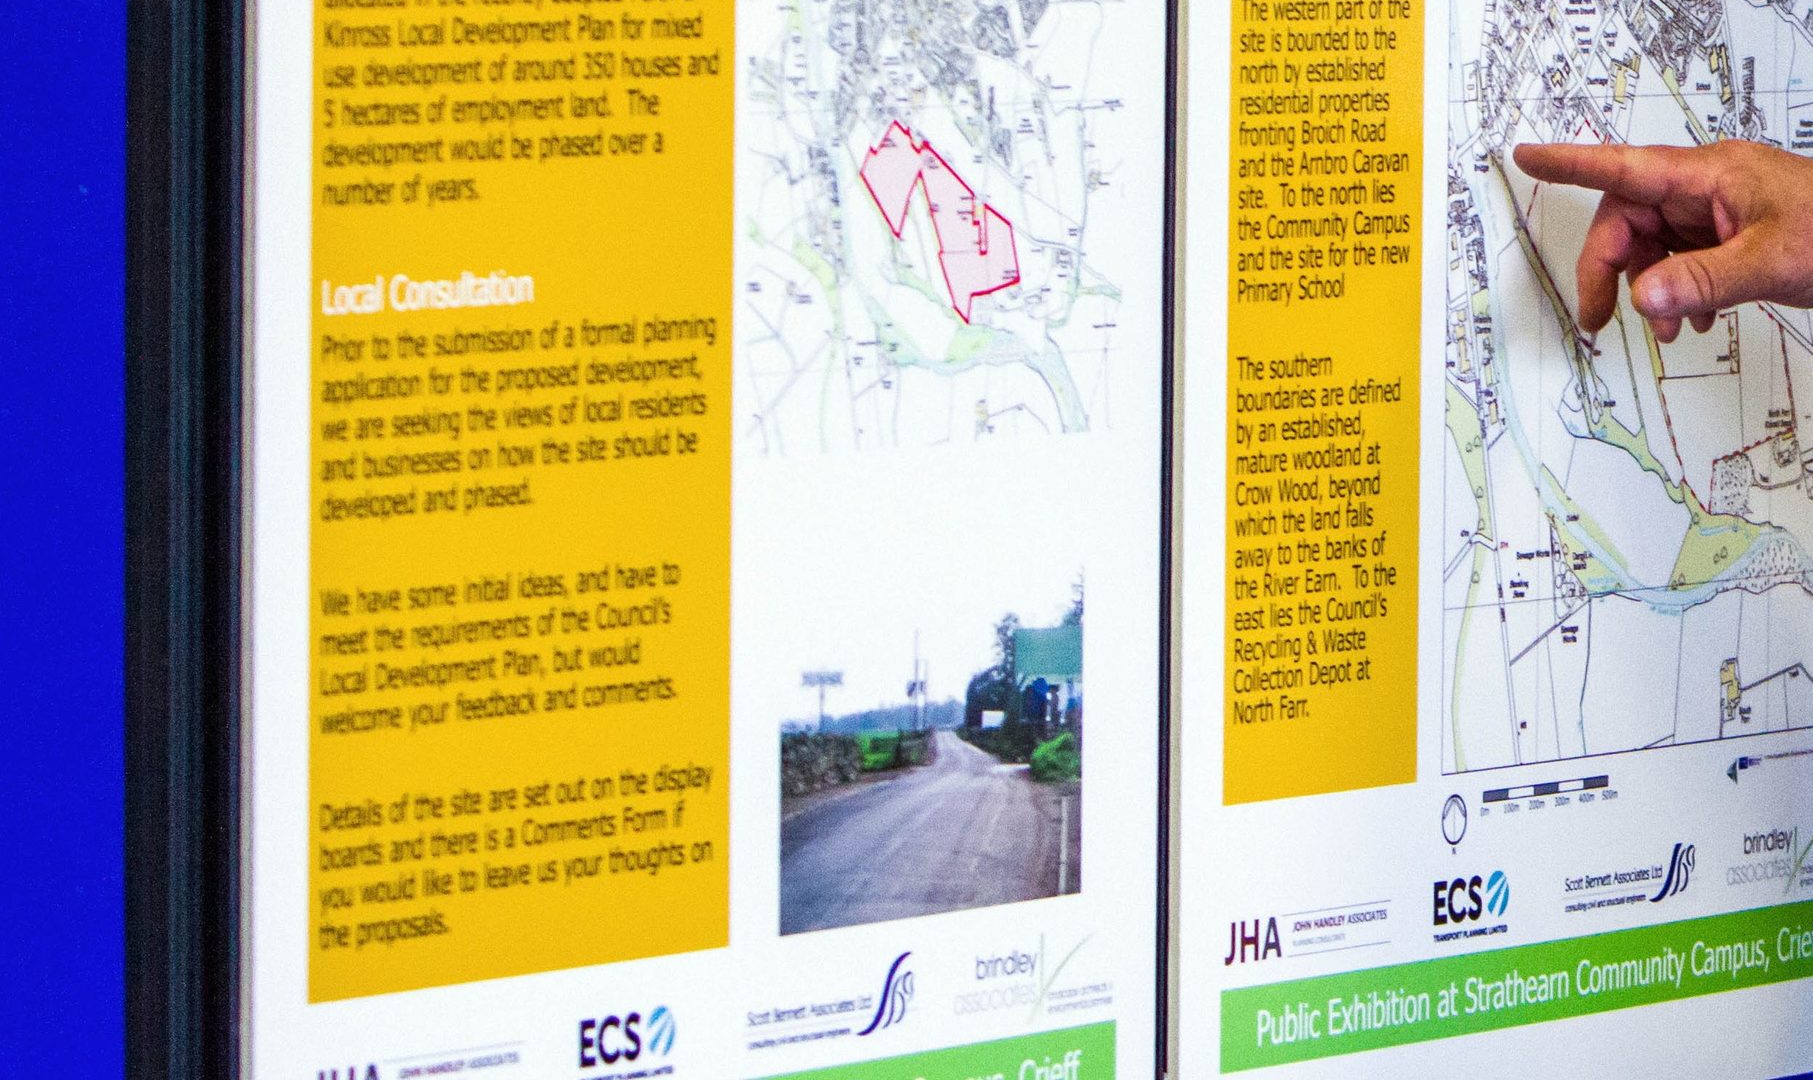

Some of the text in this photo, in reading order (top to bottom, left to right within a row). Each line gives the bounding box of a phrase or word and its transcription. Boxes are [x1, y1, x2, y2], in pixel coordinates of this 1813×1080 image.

[1239, 24, 1397, 54] site is bounded to the
[1237, 209, 1410, 242] the Community Campus
[321, 272, 535, 316] Local Consultation
[1237, 271, 1346, 306] Primary School
[1236, 351, 1333, 381] The southern
[1236, 376, 1402, 413] boundaries are defined
[1235, 410, 1366, 449] by an established,
[1235, 469, 1381, 507] Crow Wood, beyond
[1233, 627, 1367, 666] Recycling & Waste
[1743, 828, 1794, 856] brindley
[1565, 864, 1663, 892] Scott Bennett Associates Ltd
[1727, 858, 1792, 886] associates
[1433, 875, 1482, 926] ECS
[1293, 909, 1388, 933] JOHN HANDLEY ASSOCIATES
[1225, 917, 1282, 966] JHA
[975, 951, 1039, 981] brindley
[1255, 998, 1320, 1050] Public
[1323, 984, 1433, 1036] Exhibition
[1433, 978, 1461, 1019] at
[1461, 964, 1570, 1014] Strathearn
[1575, 943, 1684, 996] Community
[1691, 936, 1770, 989] Campus,
[578, 1012, 641, 1069] ECS
[1018, 1049, 1083, 1080] Crieff
